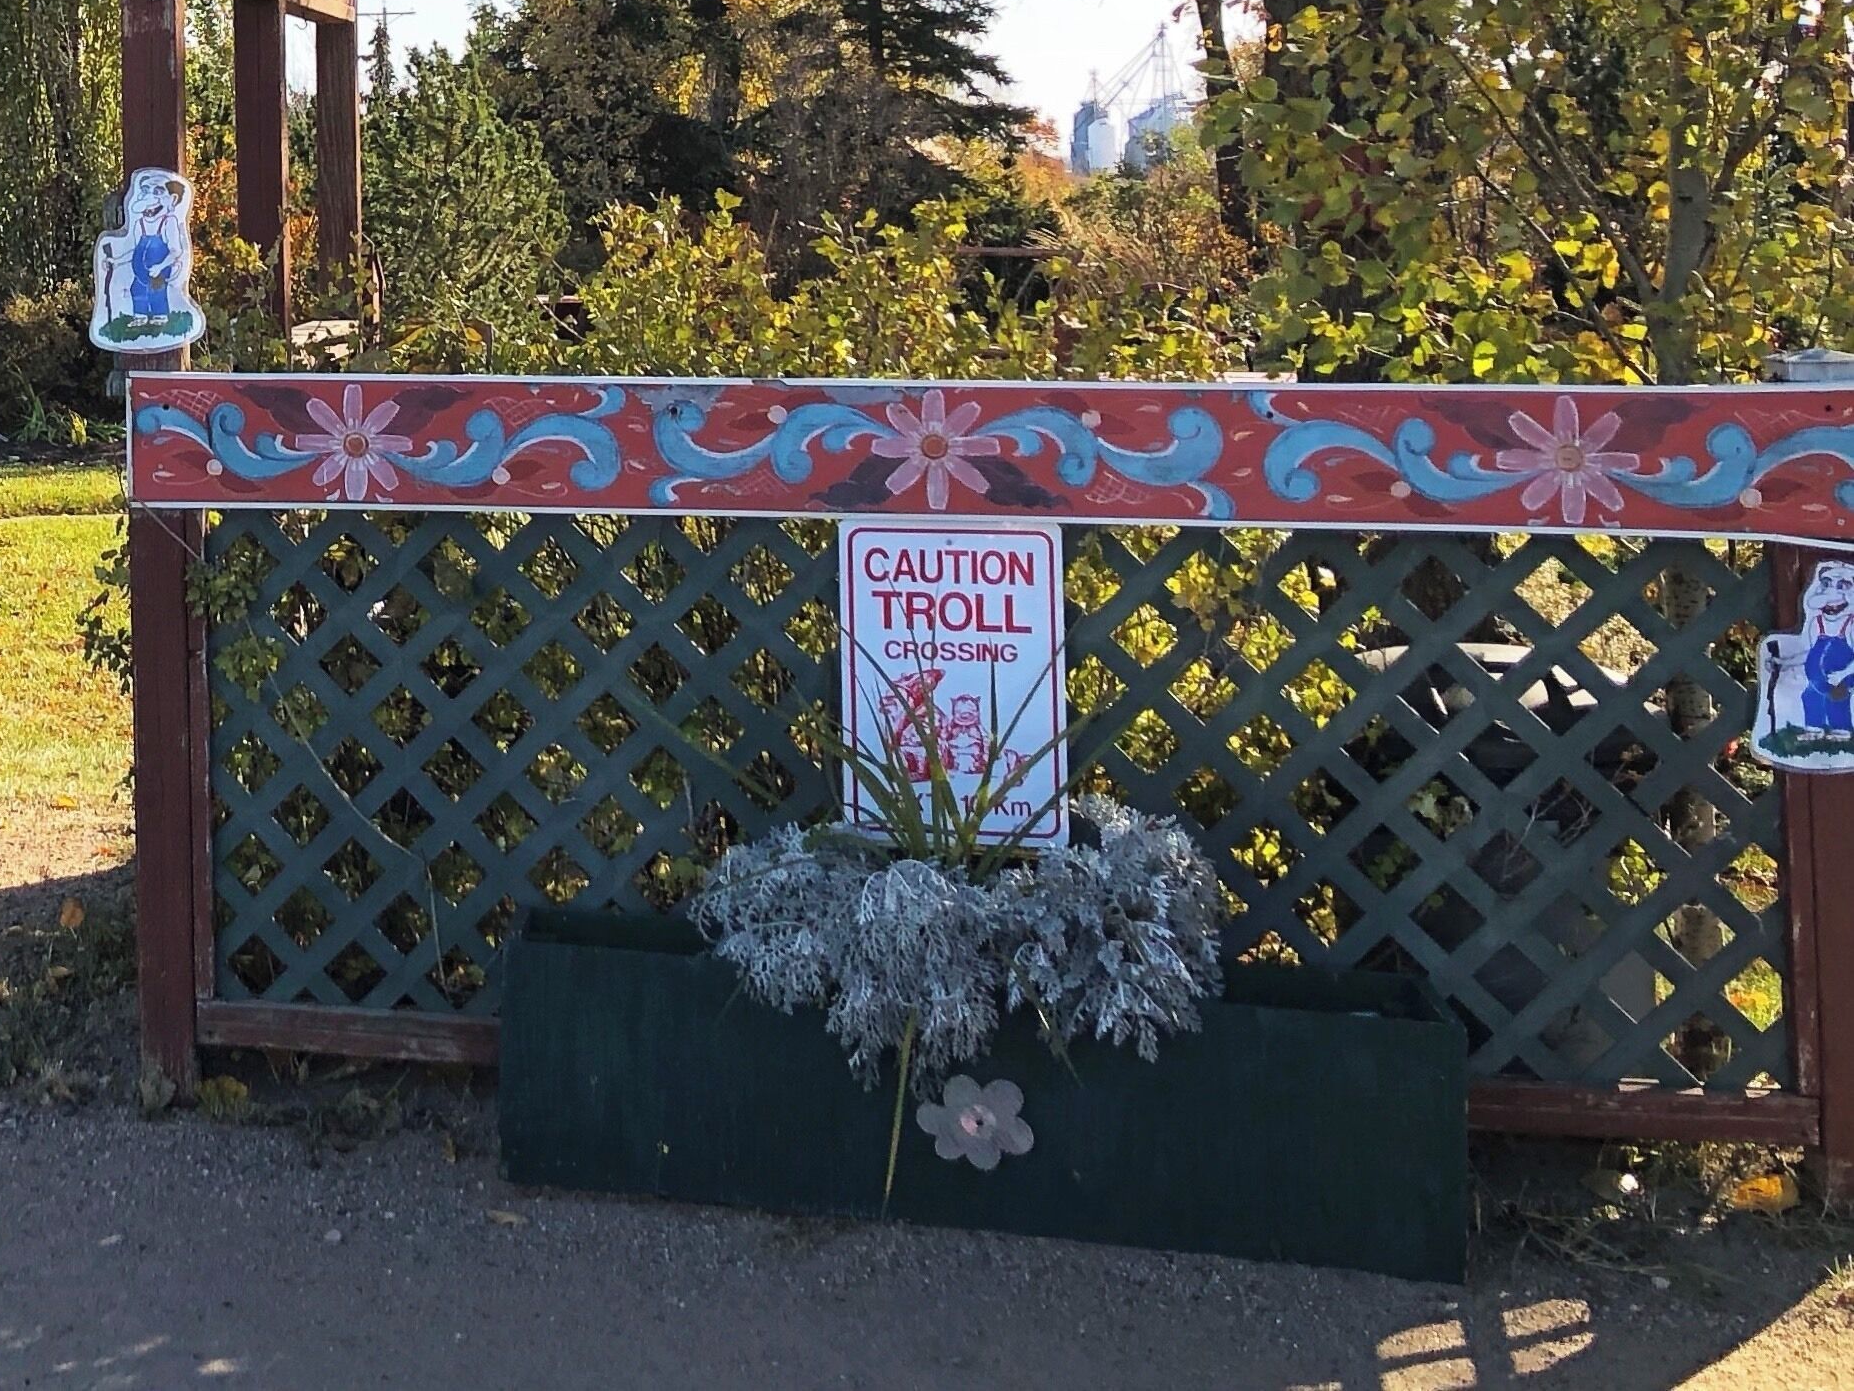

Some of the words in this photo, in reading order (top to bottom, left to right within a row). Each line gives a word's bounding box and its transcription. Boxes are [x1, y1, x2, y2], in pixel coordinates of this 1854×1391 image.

[863, 546, 1035, 587] CAUTION
[871, 589, 1033, 634] TROLL
[883, 639, 1019, 663] CROSSING
